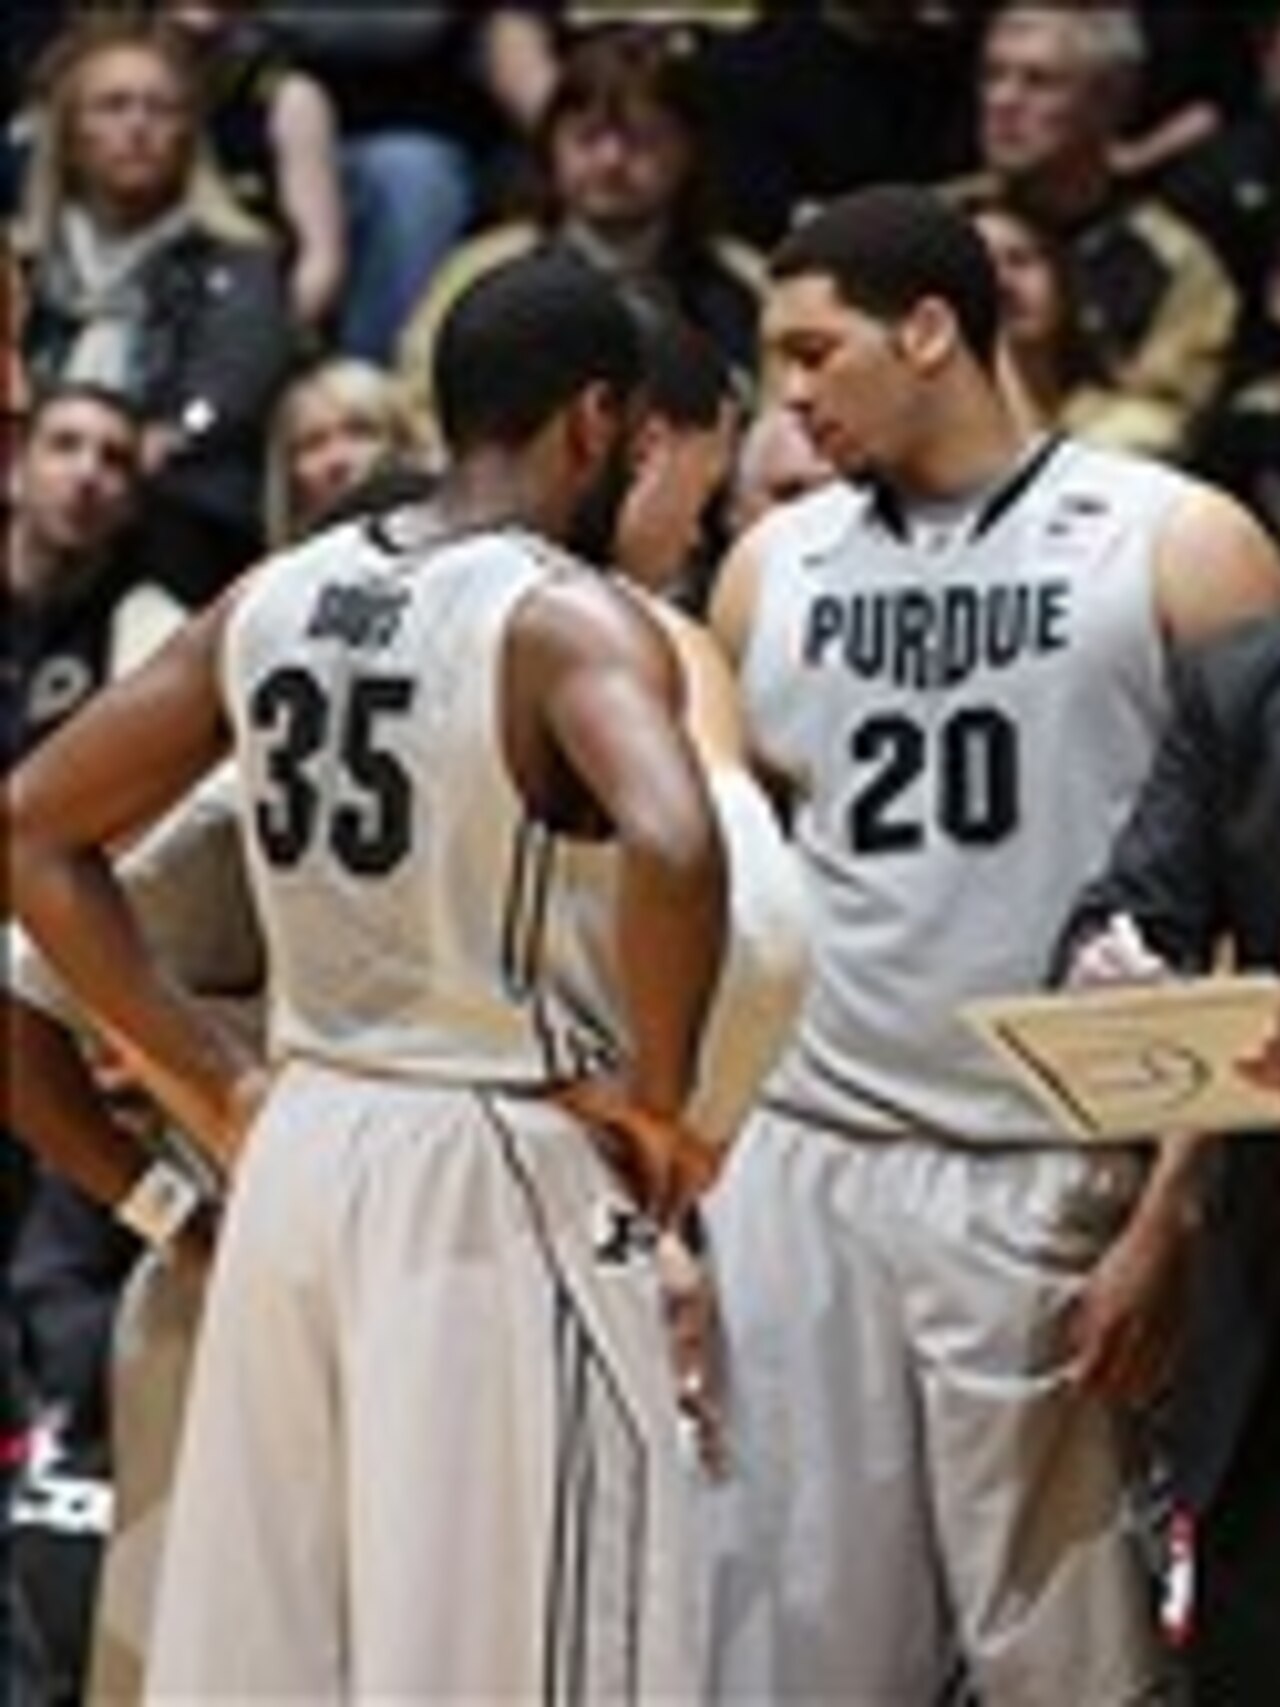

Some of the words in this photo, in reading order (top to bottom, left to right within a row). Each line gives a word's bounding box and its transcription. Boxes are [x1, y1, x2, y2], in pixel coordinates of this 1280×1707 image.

[802, 579, 1070, 690] PURDUE
[252, 667, 414, 876] 35
[849, 704, 1020, 855] 20
